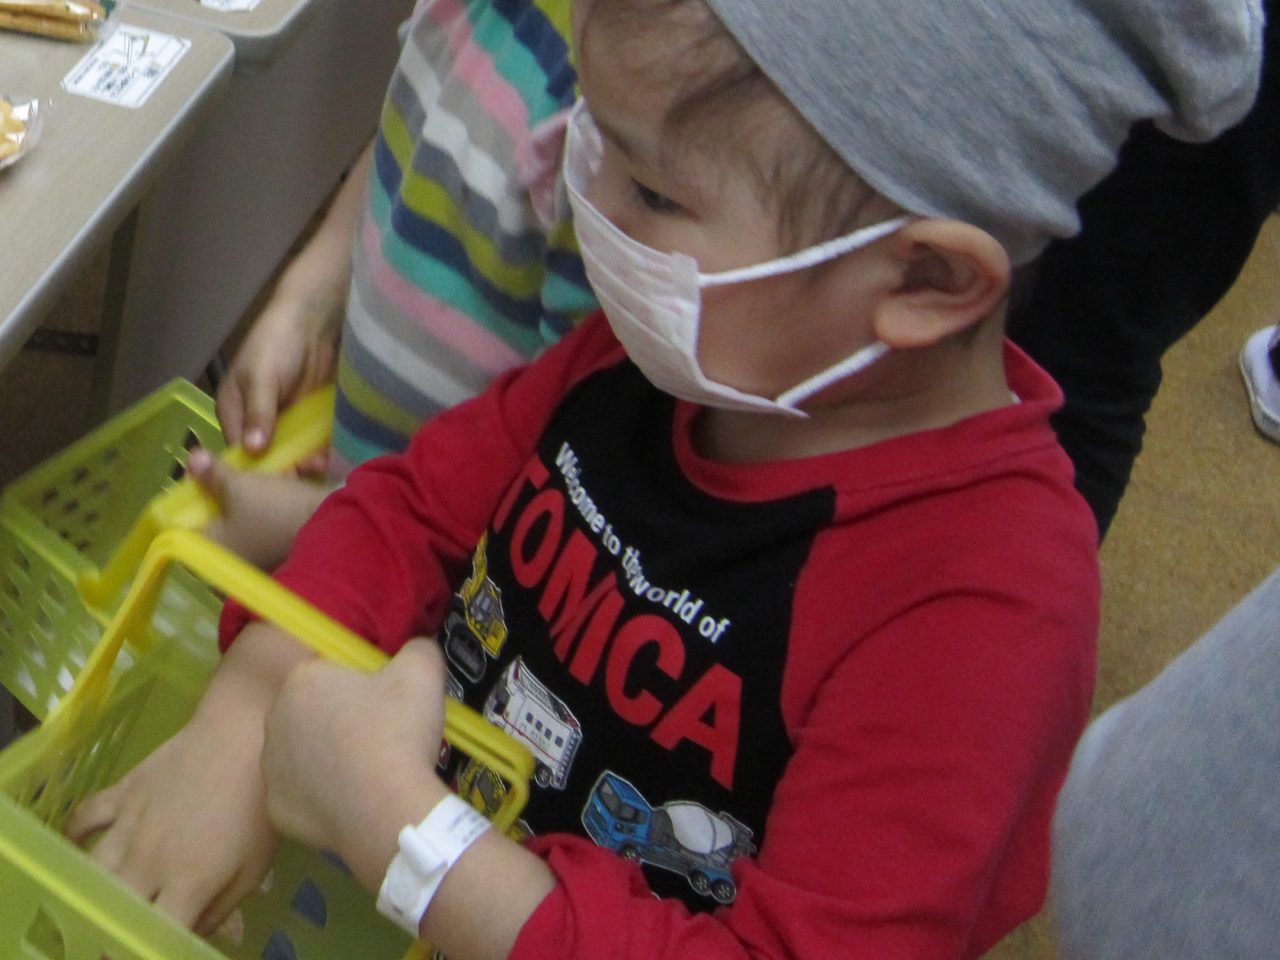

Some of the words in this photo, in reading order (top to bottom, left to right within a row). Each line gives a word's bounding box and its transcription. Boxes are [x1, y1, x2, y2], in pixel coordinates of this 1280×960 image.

[493, 454, 743, 792] TOMICA
[602, 524, 623, 556] to
[628, 573, 705, 625] world
[699, 617, 732, 643] of
